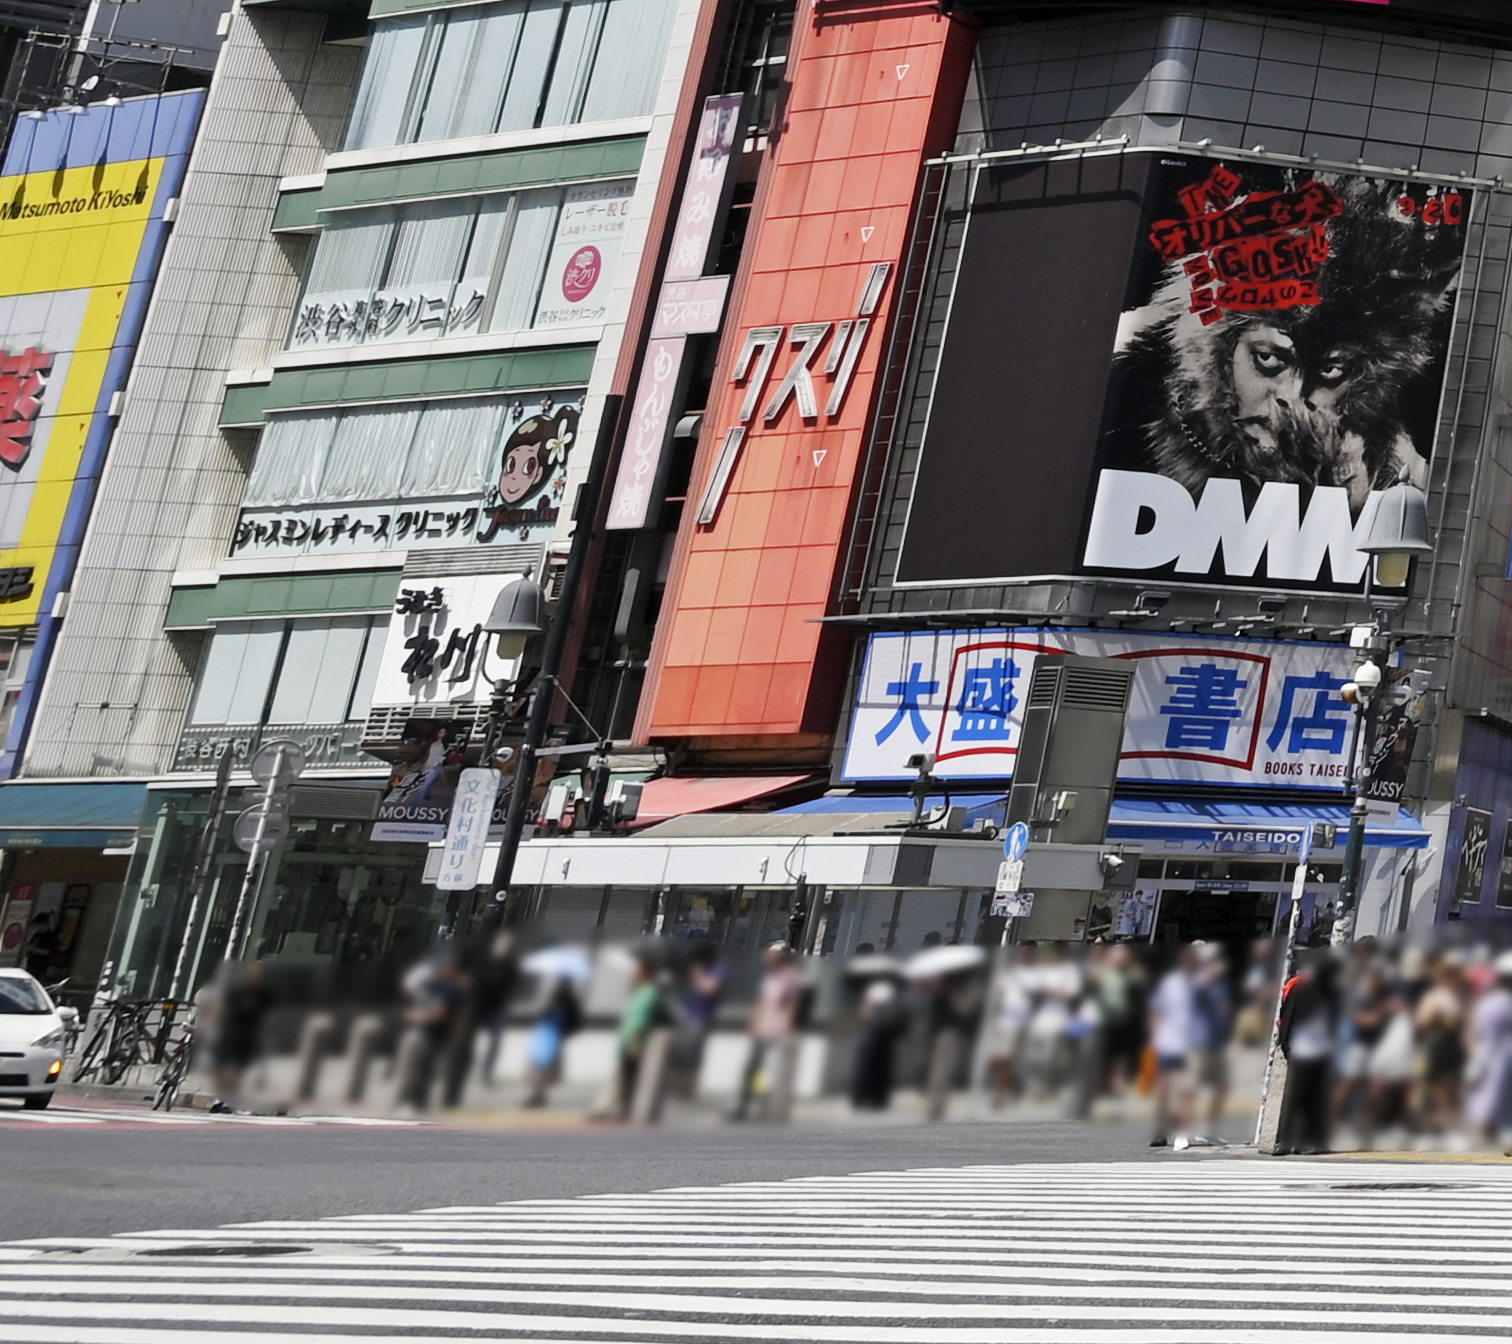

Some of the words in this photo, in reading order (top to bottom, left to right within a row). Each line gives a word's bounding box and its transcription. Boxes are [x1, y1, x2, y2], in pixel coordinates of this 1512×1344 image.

[87, 185, 149, 213] KiYoshi
[732, 317, 871, 423] クスリ
[874, 657, 1354, 758] 大盛書店
[1264, 760, 1305, 777] BOOKS
[378, 805, 449, 821] MOUSSY
[449, 777, 482, 870] 文化村通り
[1211, 830, 1300, 845] TAISEIDO
